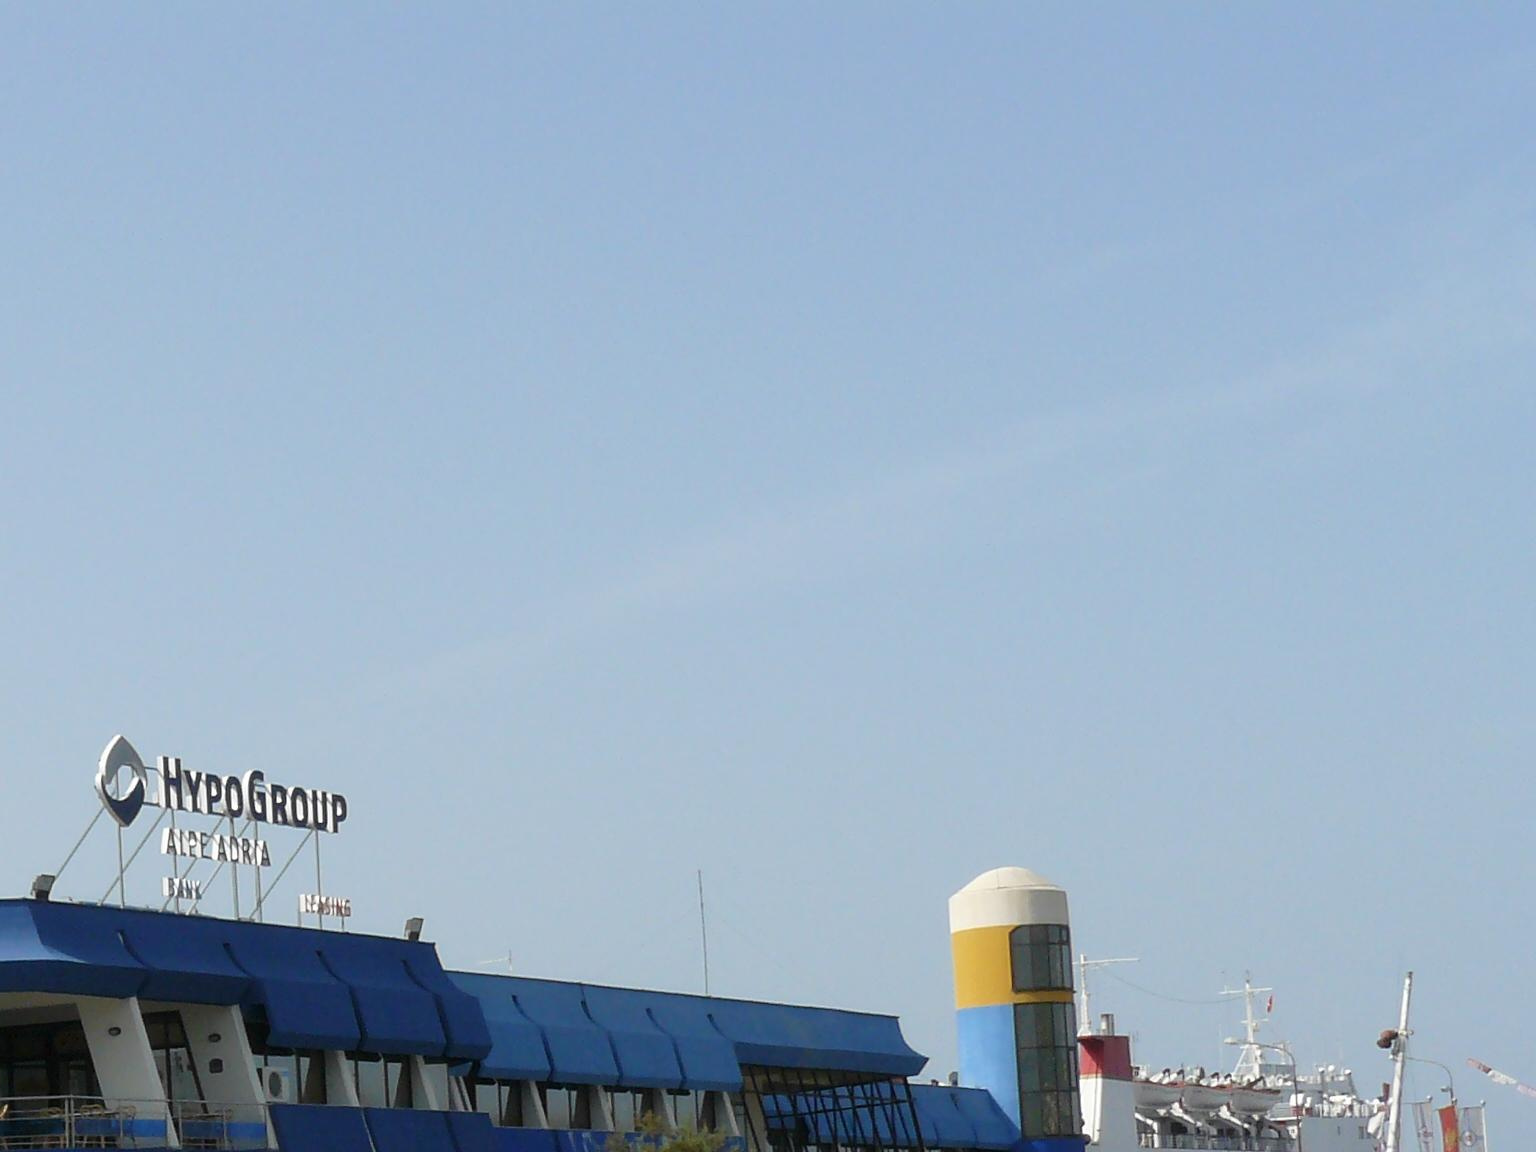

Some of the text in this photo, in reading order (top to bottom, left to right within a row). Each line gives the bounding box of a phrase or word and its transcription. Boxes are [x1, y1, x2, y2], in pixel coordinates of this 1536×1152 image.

[213, 834, 272, 867] ADRIA
[163, 877, 202, 900] BANK
[300, 893, 352, 917] LEASING
